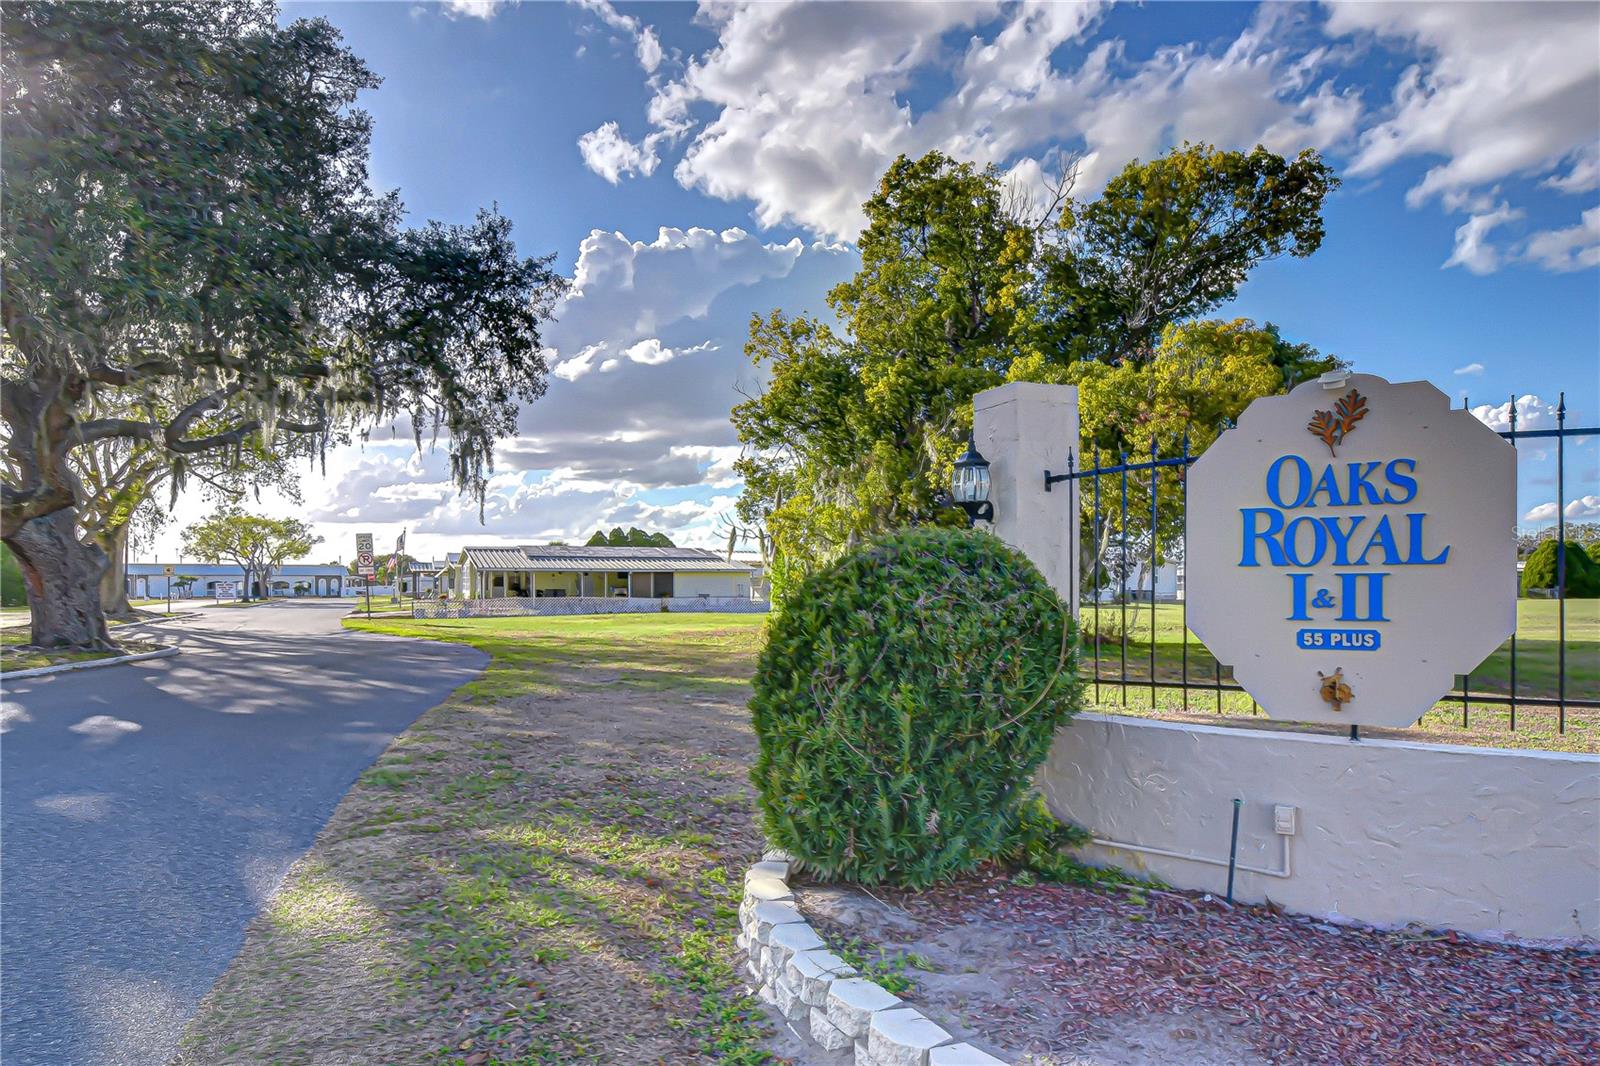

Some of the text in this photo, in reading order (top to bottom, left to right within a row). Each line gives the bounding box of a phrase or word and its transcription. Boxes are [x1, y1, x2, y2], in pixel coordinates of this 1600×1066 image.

[1266, 454, 1418, 509] OAKS
[1238, 507, 1451, 567] ROYAL
[1303, 632, 1375, 647] 55 PLUS
